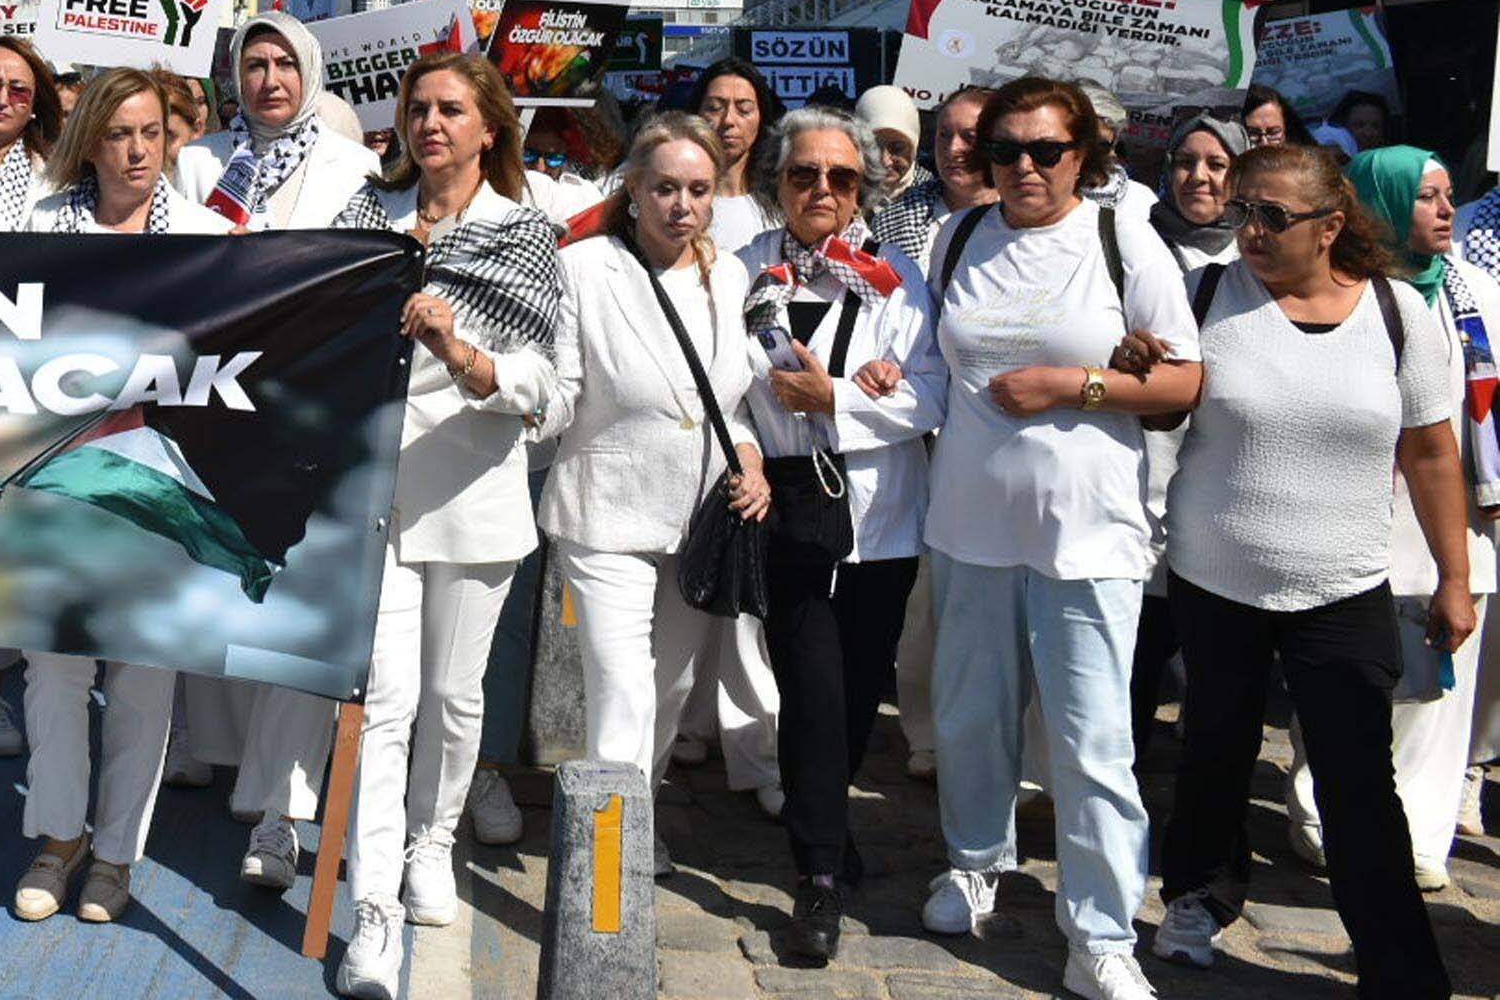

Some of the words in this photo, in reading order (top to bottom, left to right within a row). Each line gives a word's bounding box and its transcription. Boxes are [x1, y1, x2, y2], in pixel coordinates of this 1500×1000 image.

[63, 12, 158, 36] PALESTINE
[509, 23, 553, 44] ÖZGÜR
[553, 28, 605, 47] OLACAK
[1130, 18, 1210, 39] ZAMANI
[322, 46, 350, 60] HE
[755, 36, 845, 58] SÖZÜN
[325, 47, 419, 81] BIGGER
